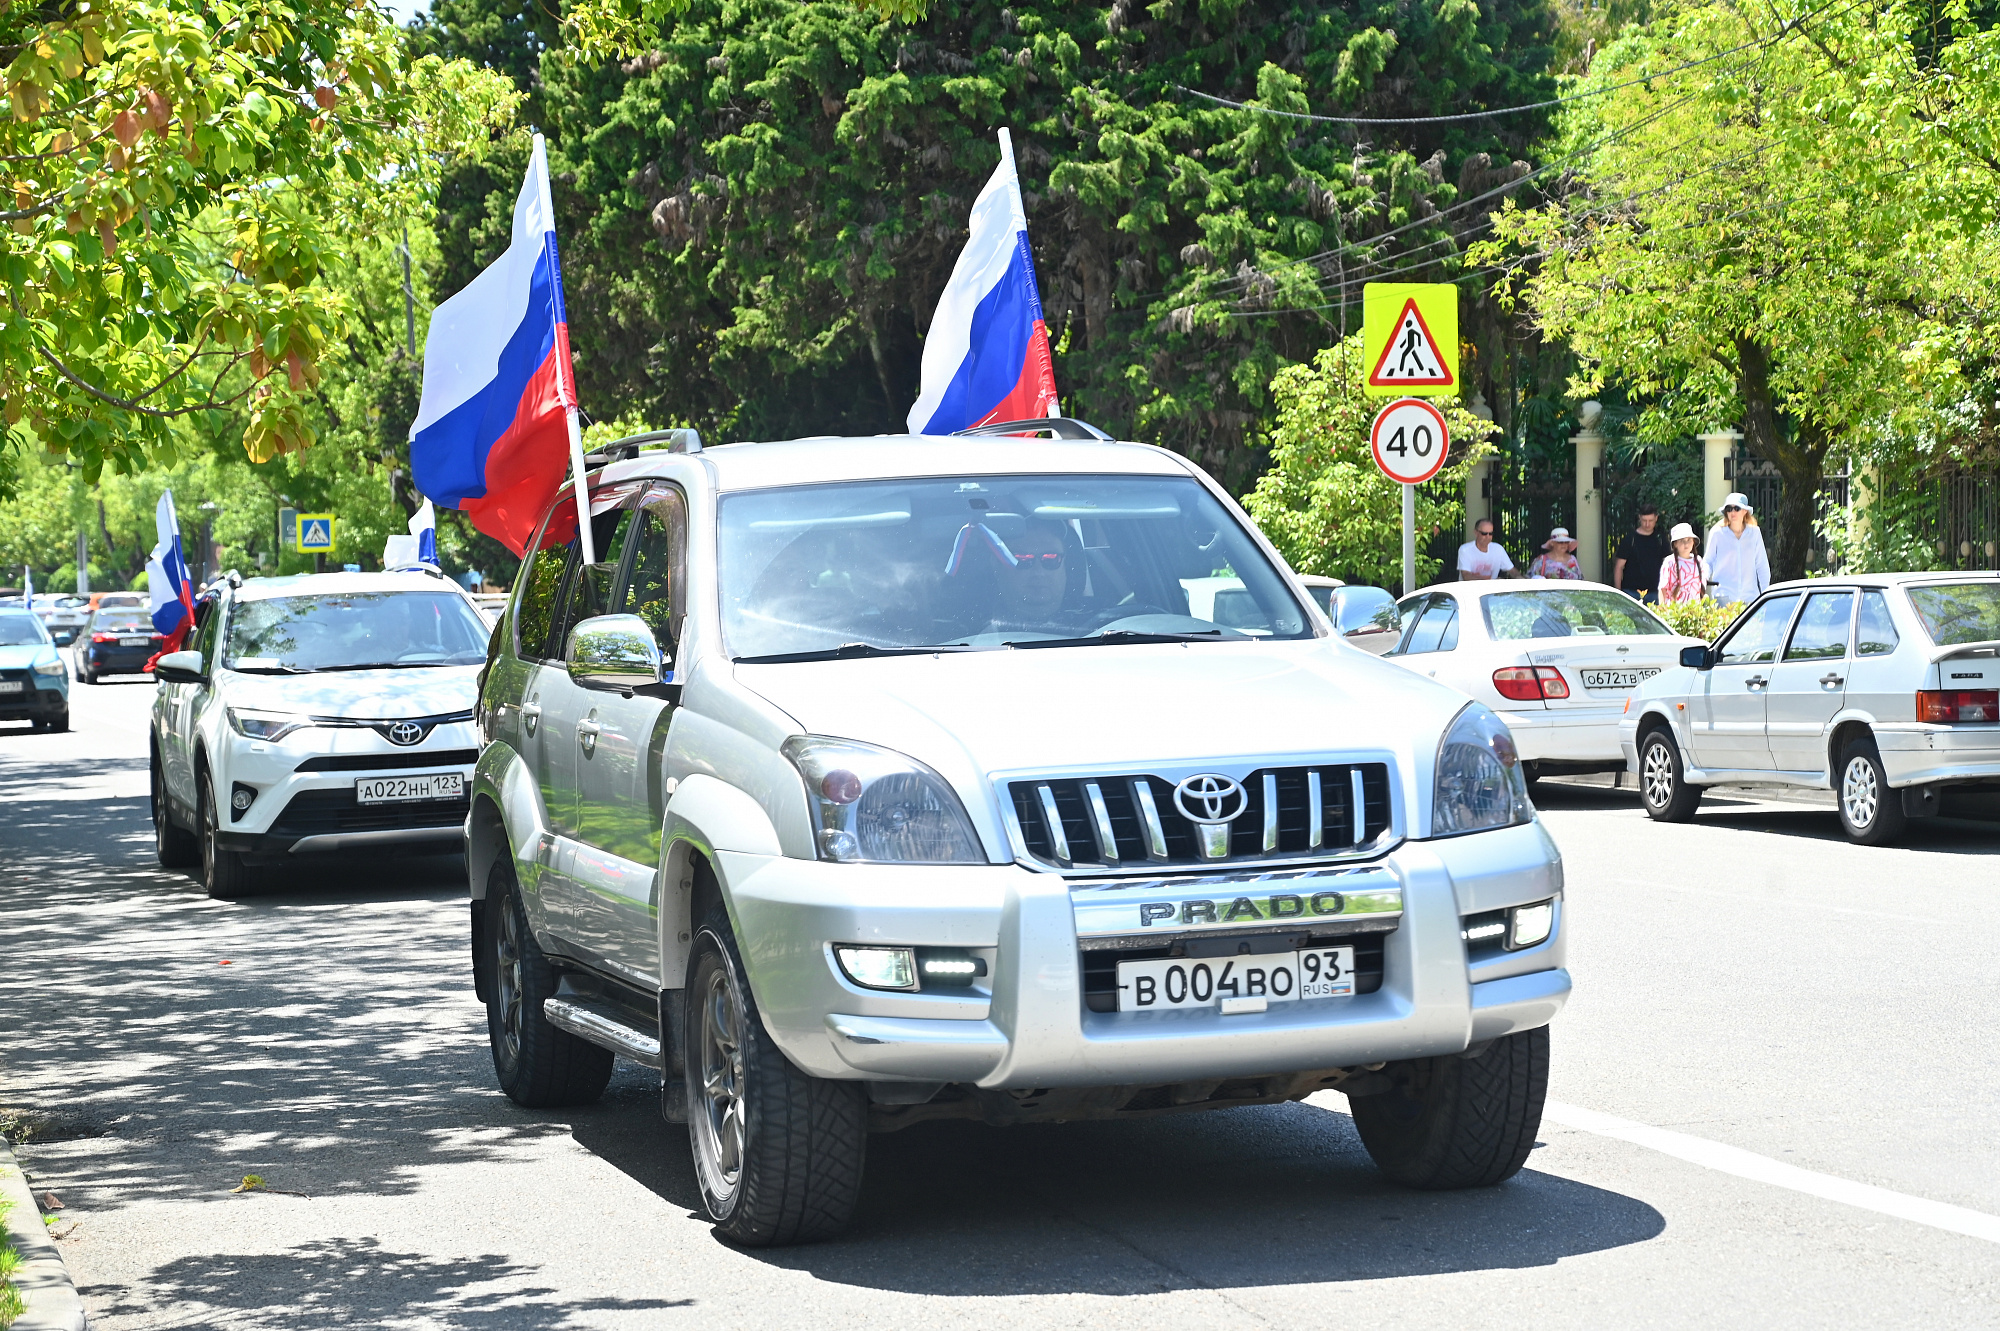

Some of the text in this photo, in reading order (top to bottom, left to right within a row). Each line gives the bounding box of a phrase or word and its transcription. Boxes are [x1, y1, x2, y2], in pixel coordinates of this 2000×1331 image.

[1386, 424, 1433, 458] 40
[1587, 672, 1638, 685] О672ТВ
[363, 776, 458, 799] А022НН 123
[1140, 891, 1346, 927] PRADO
[1135, 951, 1341, 1007] В004ВО 93
[1303, 983, 1331, 996] RUS
